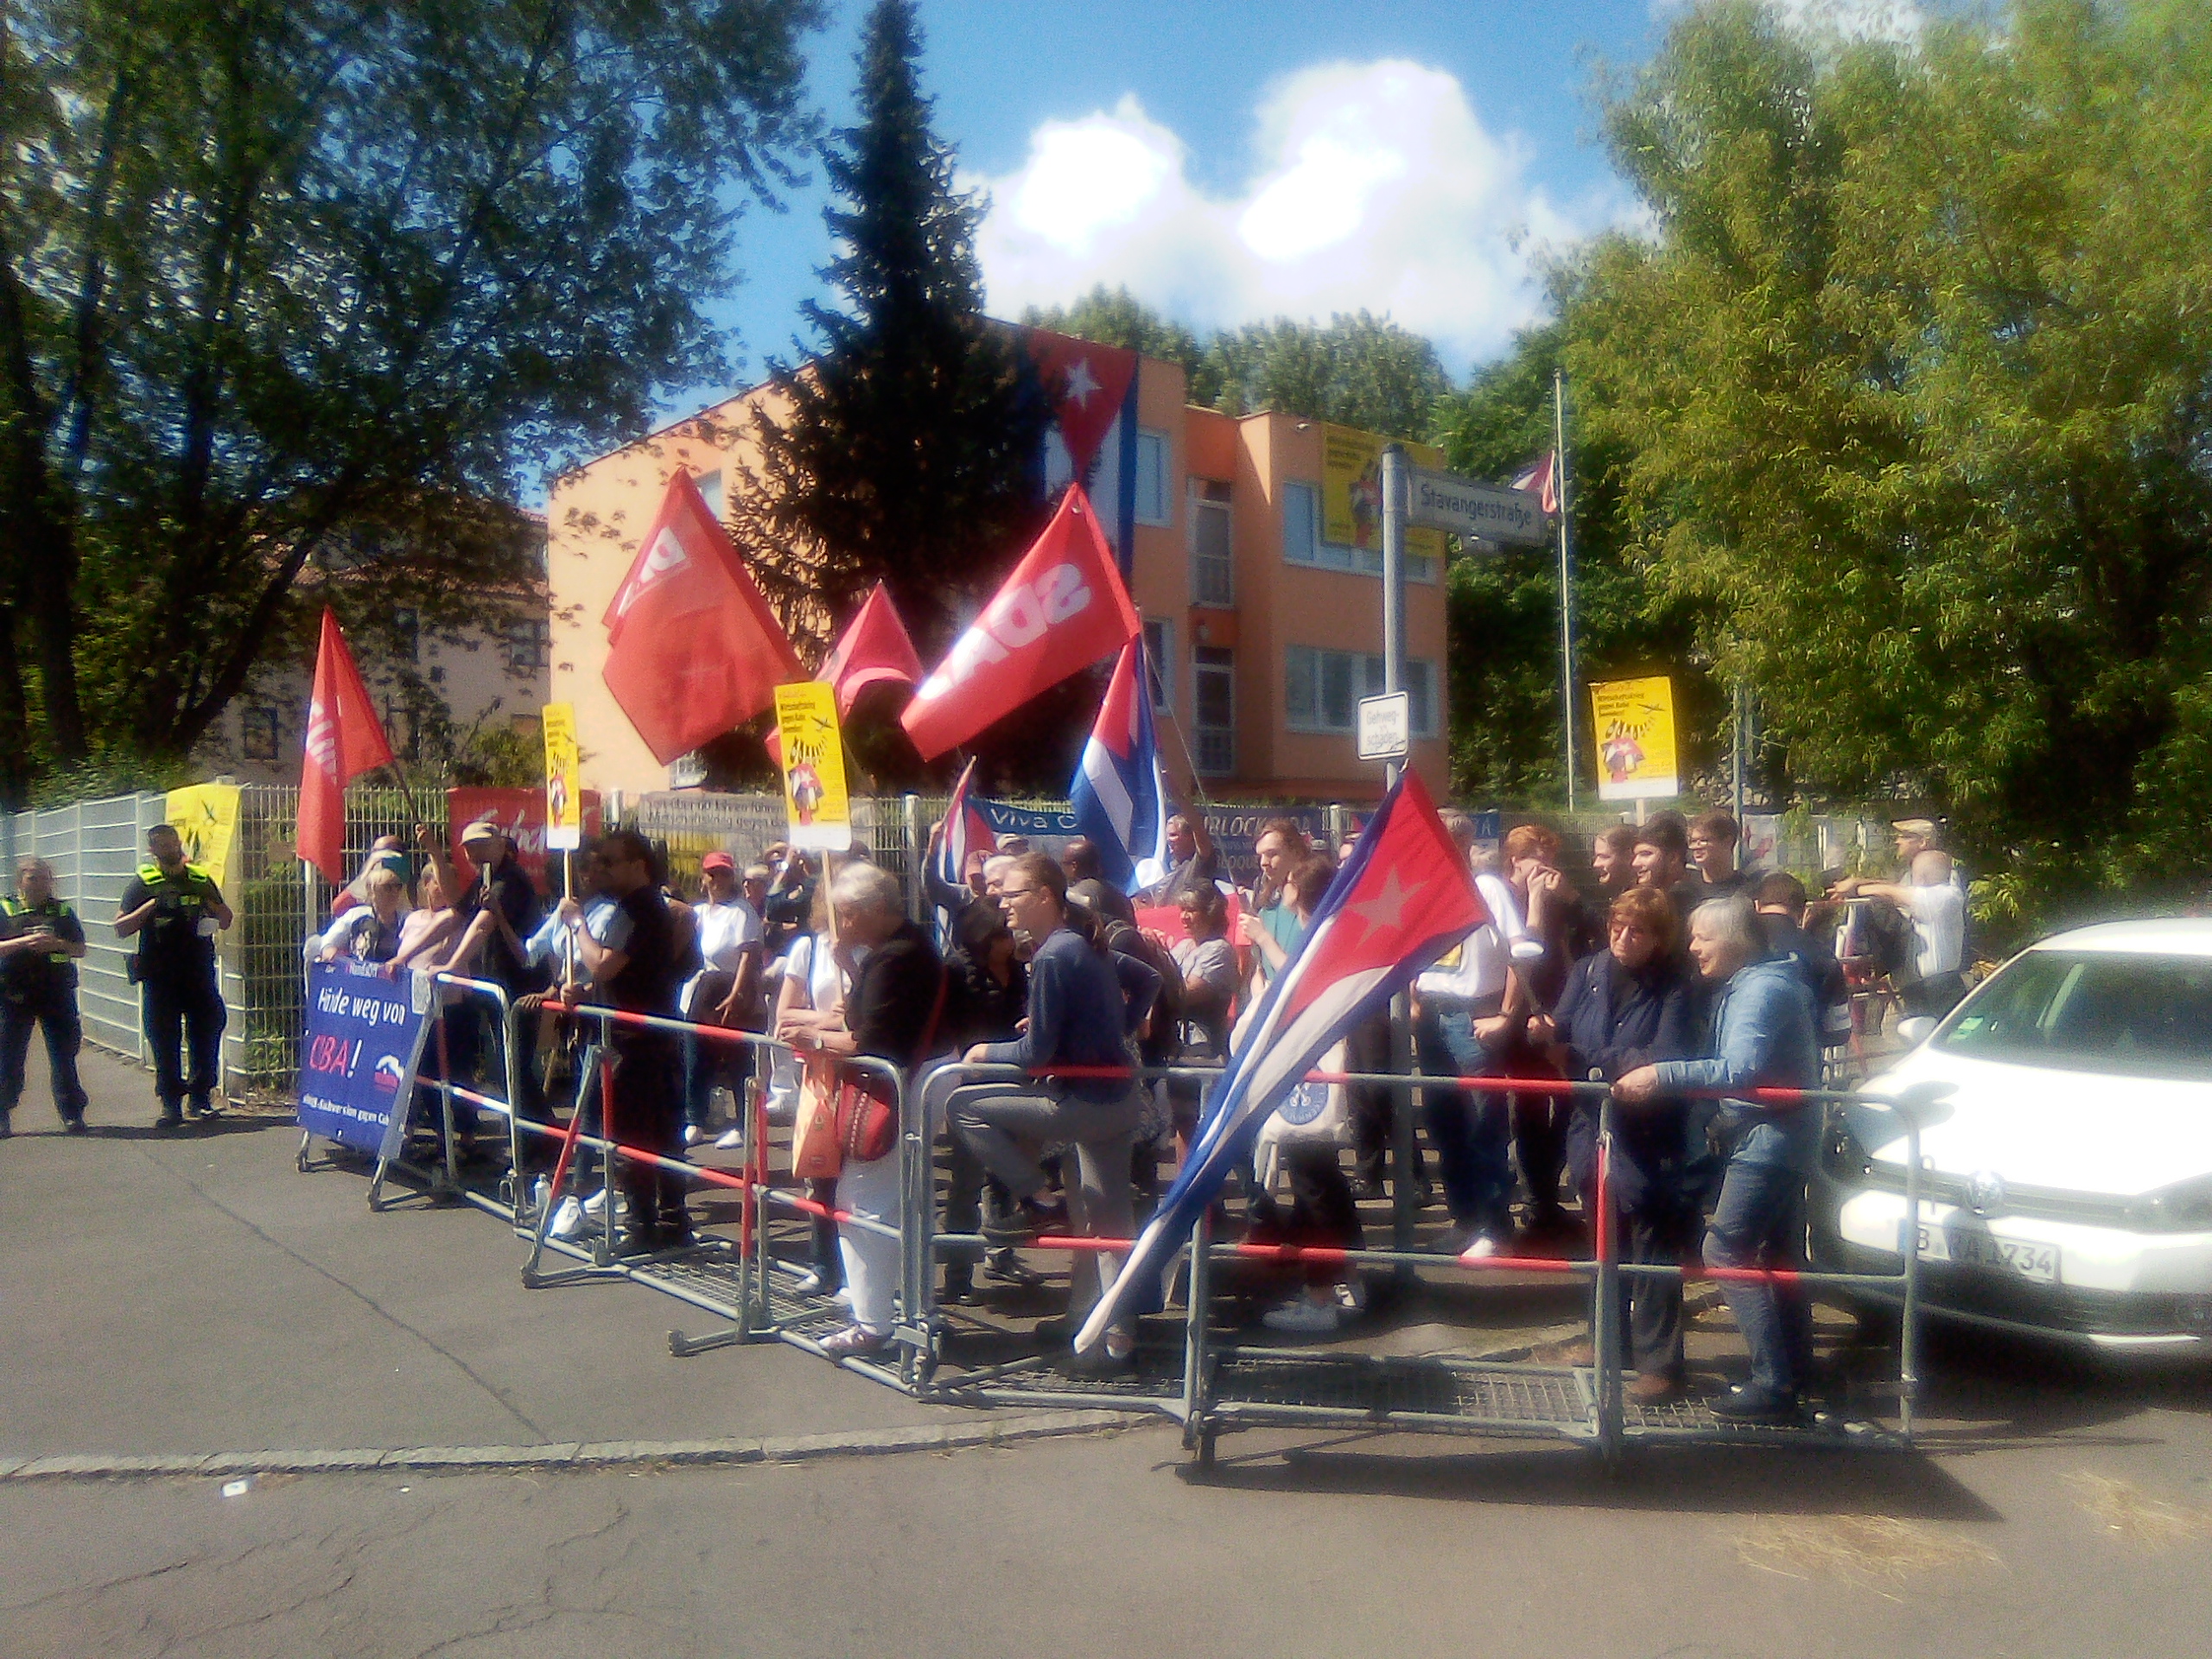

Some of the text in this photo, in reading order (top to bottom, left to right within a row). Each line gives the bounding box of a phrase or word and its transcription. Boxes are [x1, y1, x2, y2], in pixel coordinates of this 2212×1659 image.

[1421, 483, 1533, 531] Stavangerstraße
[990, 807, 1048, 830] Viva
[352, 995, 381, 1027] weg
[383, 1001, 406, 1026] von
